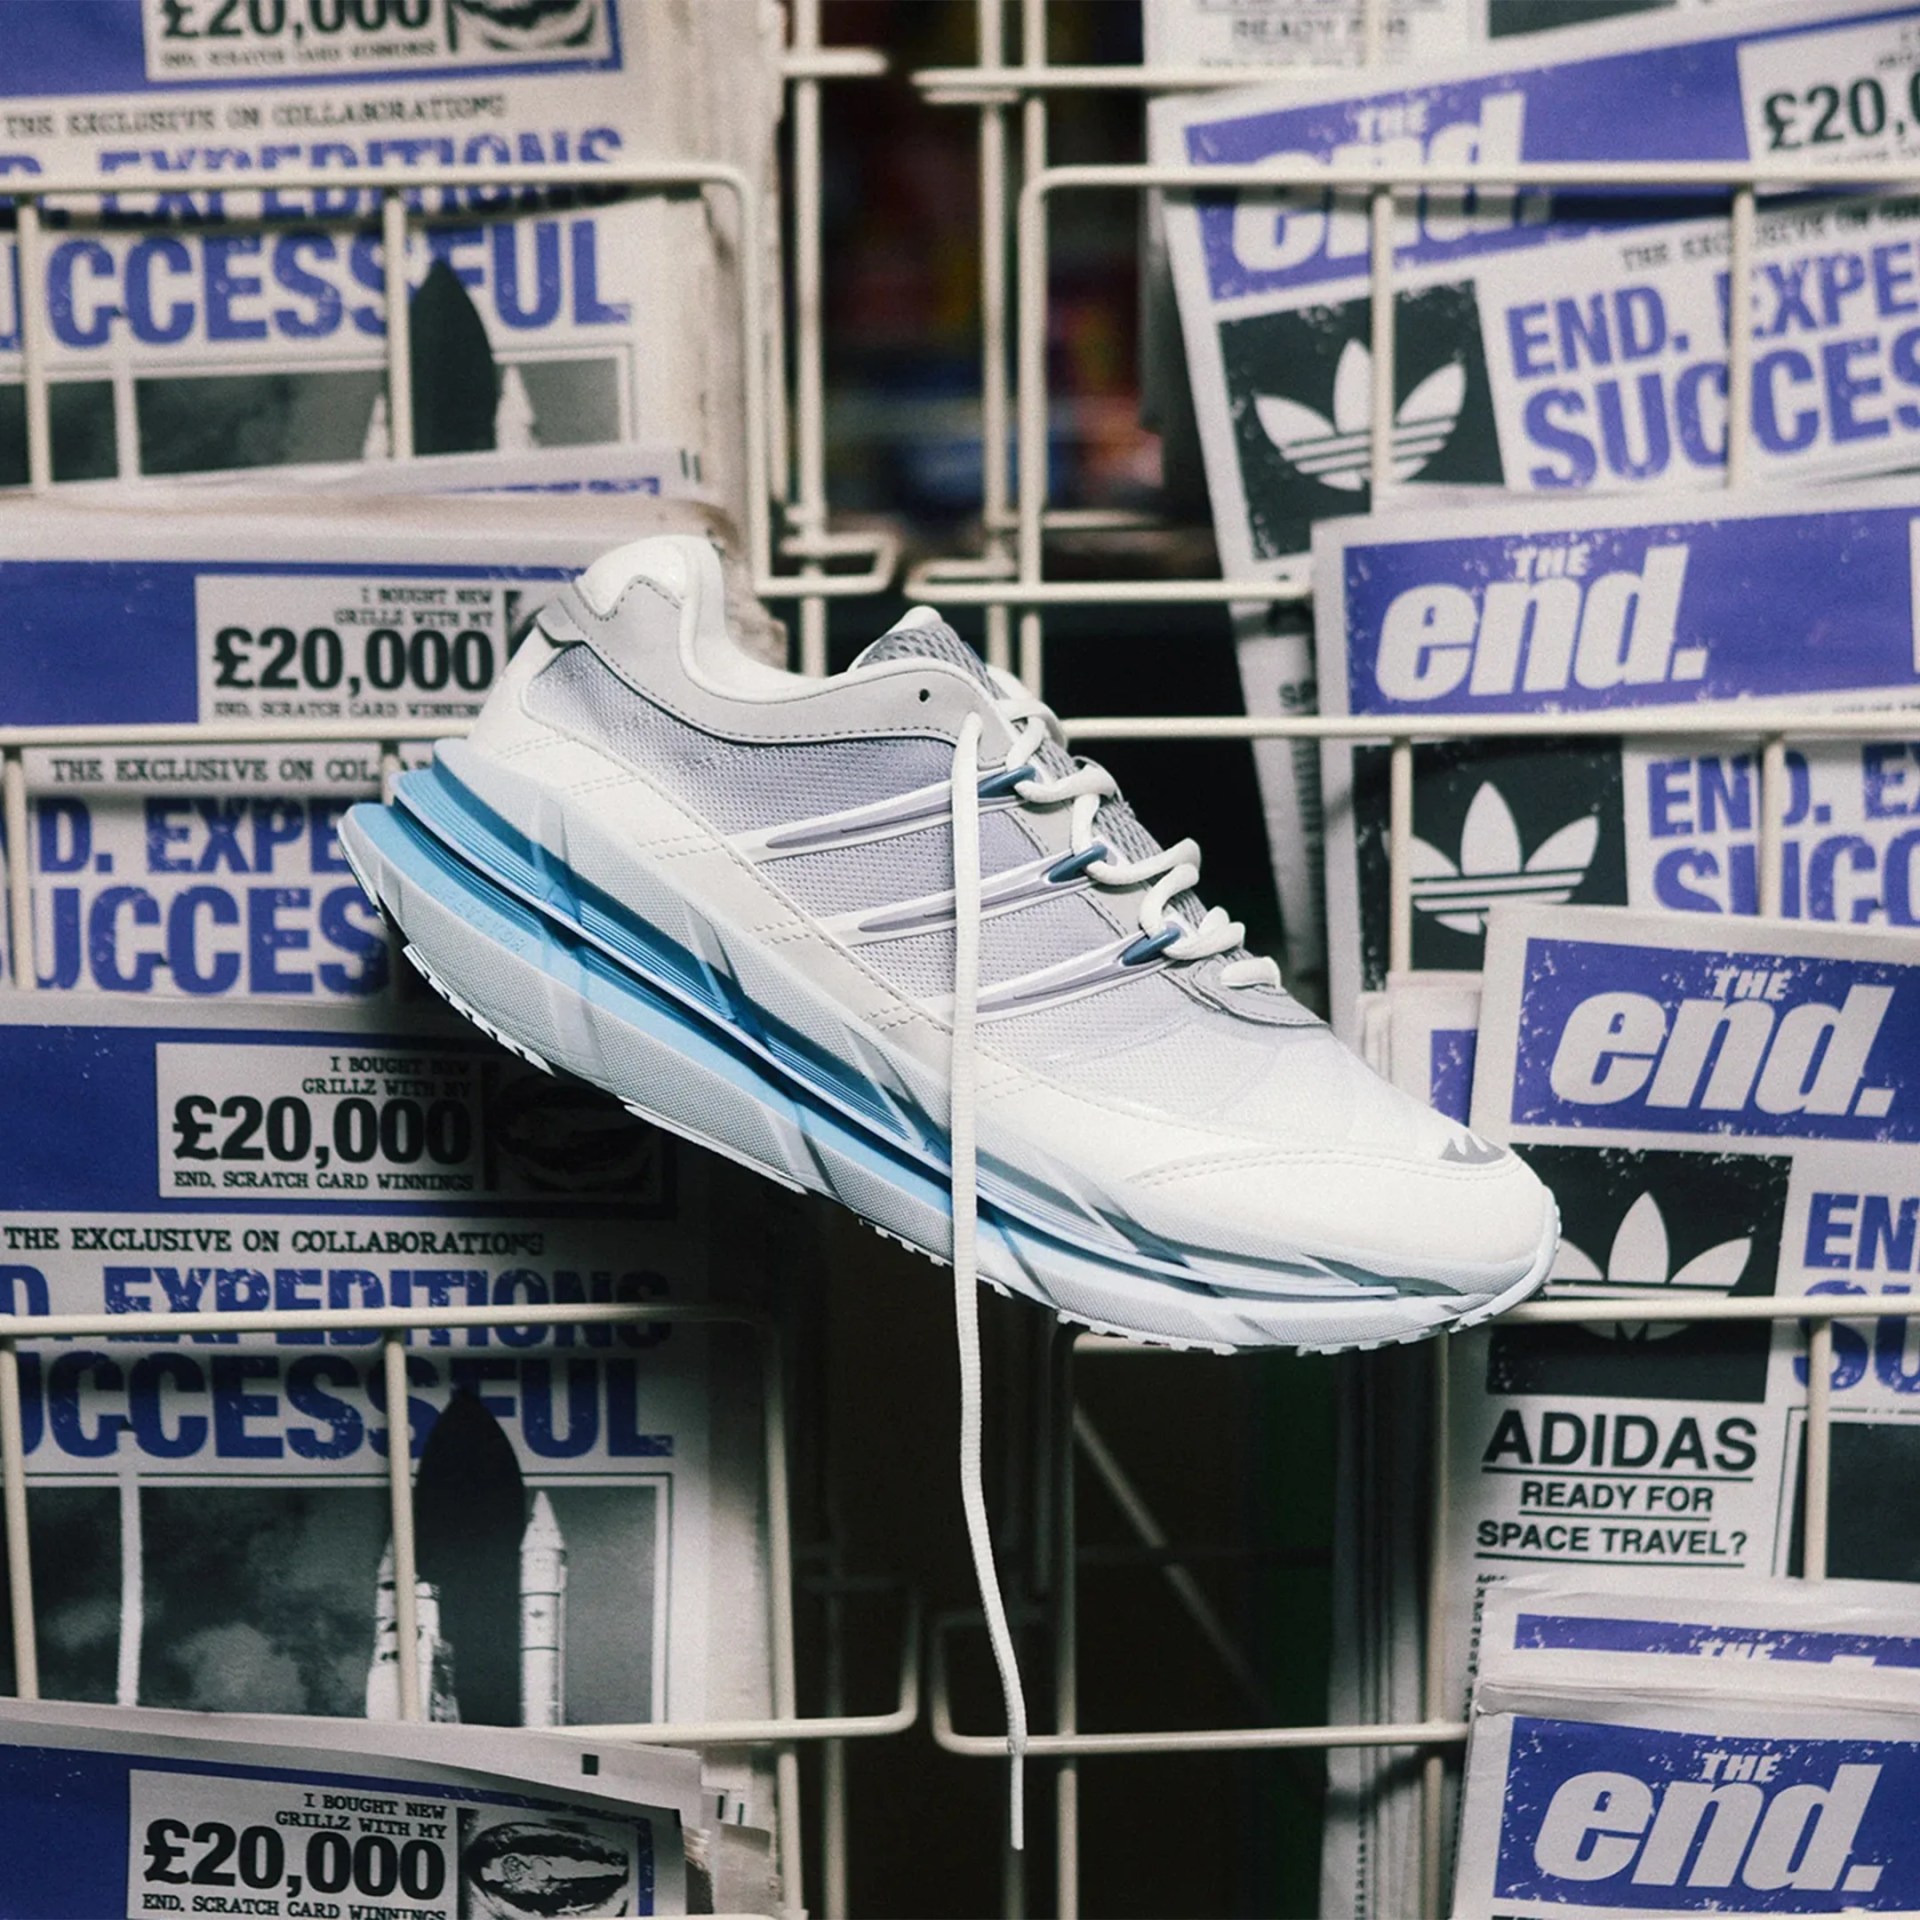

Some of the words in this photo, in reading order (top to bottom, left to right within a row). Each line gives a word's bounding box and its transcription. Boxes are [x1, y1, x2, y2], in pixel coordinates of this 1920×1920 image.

[1765, 72, 1920, 150] £20,
[1506, 286, 1689, 380] END.
[1512, 543, 1589, 579] THE
[378, 588, 447, 606] BOUGHT
[455, 589, 493, 606] NEW
[413, 610, 461, 627] WITH
[468, 610, 494, 628] MY
[1374, 544, 1708, 701] end.
[214, 625, 495, 697] £20,000
[260, 701, 342, 719] SCRATCH
[349, 702, 398, 719] CARD
[407, 702, 485, 719] WINNIN
[50, 758, 102, 783] THE
[115, 758, 269, 783] EXCLUSIVE
[279, 759, 313, 783] ON
[325, 758, 382, 783] COL
[1861, 743, 1920, 821] E
[1713, 968, 1792, 1000] THE
[330, 1056, 341, 1072] I
[348, 1056, 424, 1075] BOUGHT
[1549, 983, 1896, 1118] end.
[302, 1077, 377, 1096] GRILLZ
[384, 1079, 435, 1097] WITH
[172, 1094, 471, 1169] £20,000
[174, 1170, 216, 1189] END.
[222, 1171, 309, 1190] SCRATCH
[316, 1172, 370, 1191] CARD
[377, 1173, 474, 1192] WINNINGS
[4, 1226, 60, 1251] THE
[70, 1227, 232, 1252] EXCLUSIVE
[243, 1230, 280, 1253] ON
[291, 1230, 544, 1256] COLLABORATIONS
[1803, 1191, 1920, 1273] EN
[102, 1264, 673, 1348] EXPEDITIONS
[1481, 1409, 1758, 1472] ADIDAS
[1520, 1481, 1638, 1511] READY
[1645, 1485, 1714, 1513] FOR
[1476, 1519, 1590, 1552] SPACE
[1602, 1528, 1748, 1556] TRAVEL?
[1700, 1750, 1784, 1784] THE
[303, 1792, 316, 1809] I
[323, 1794, 399, 1816] BOUGHT
[406, 1803, 447, 1820] NEW
[275, 1810, 351, 1832] GRILLZ
[359, 1817, 411, 1837] WITH
[418, 1824, 448, 1840] MY
[1533, 1763, 1885, 1893] end.
[143, 1818, 446, 1901] £20,000
[142, 1893, 186, 1913] END.
[191, 1896, 280, 1917] SCRATCH
[286, 1900, 341, 1920] CARD
